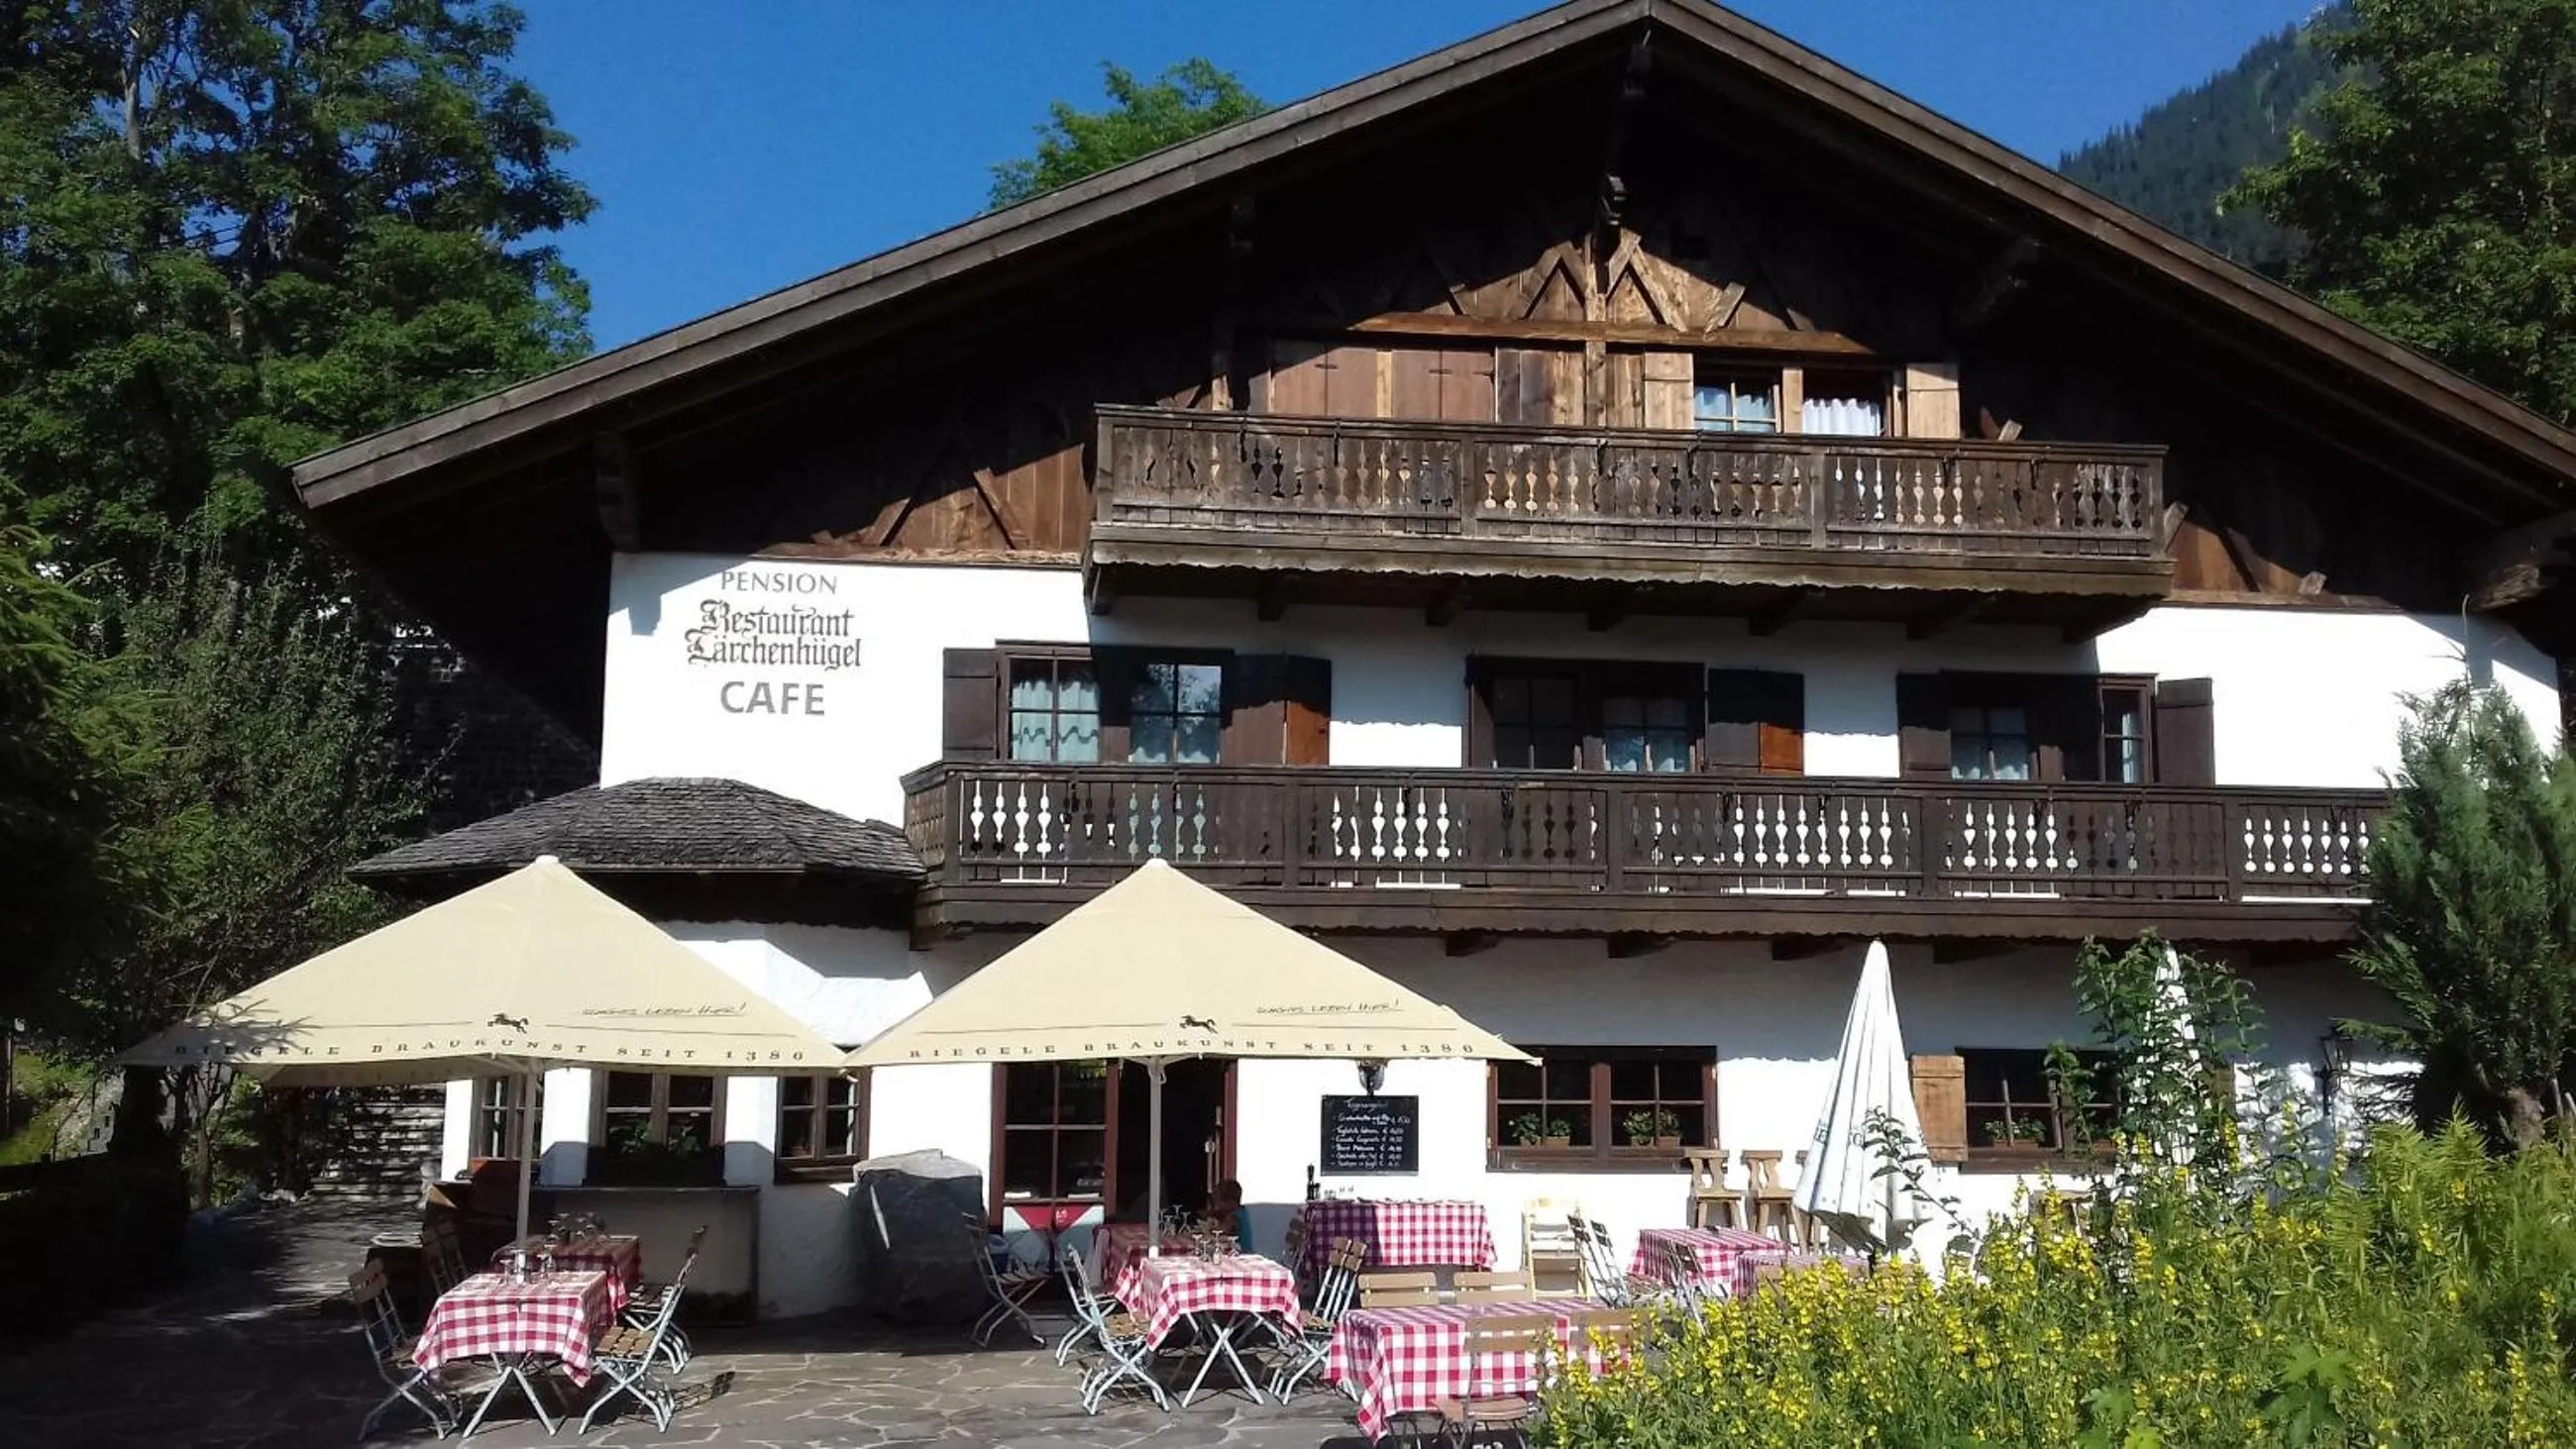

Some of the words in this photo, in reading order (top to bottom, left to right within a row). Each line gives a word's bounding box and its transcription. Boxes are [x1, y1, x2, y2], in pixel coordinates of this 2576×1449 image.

[720, 570, 837, 594] PENSION
[699, 598, 855, 637] Restaurant
[685, 628, 862, 672] Lärchenhügel
[720, 680, 825, 716] CAFE
[616, 1048, 697, 1059] SEIT
[910, 1045, 1056, 1058] RIEGELE
[1084, 1039, 1277, 1052] BRAUKUNST
[1304, 1043, 1375, 1053] SEIT
